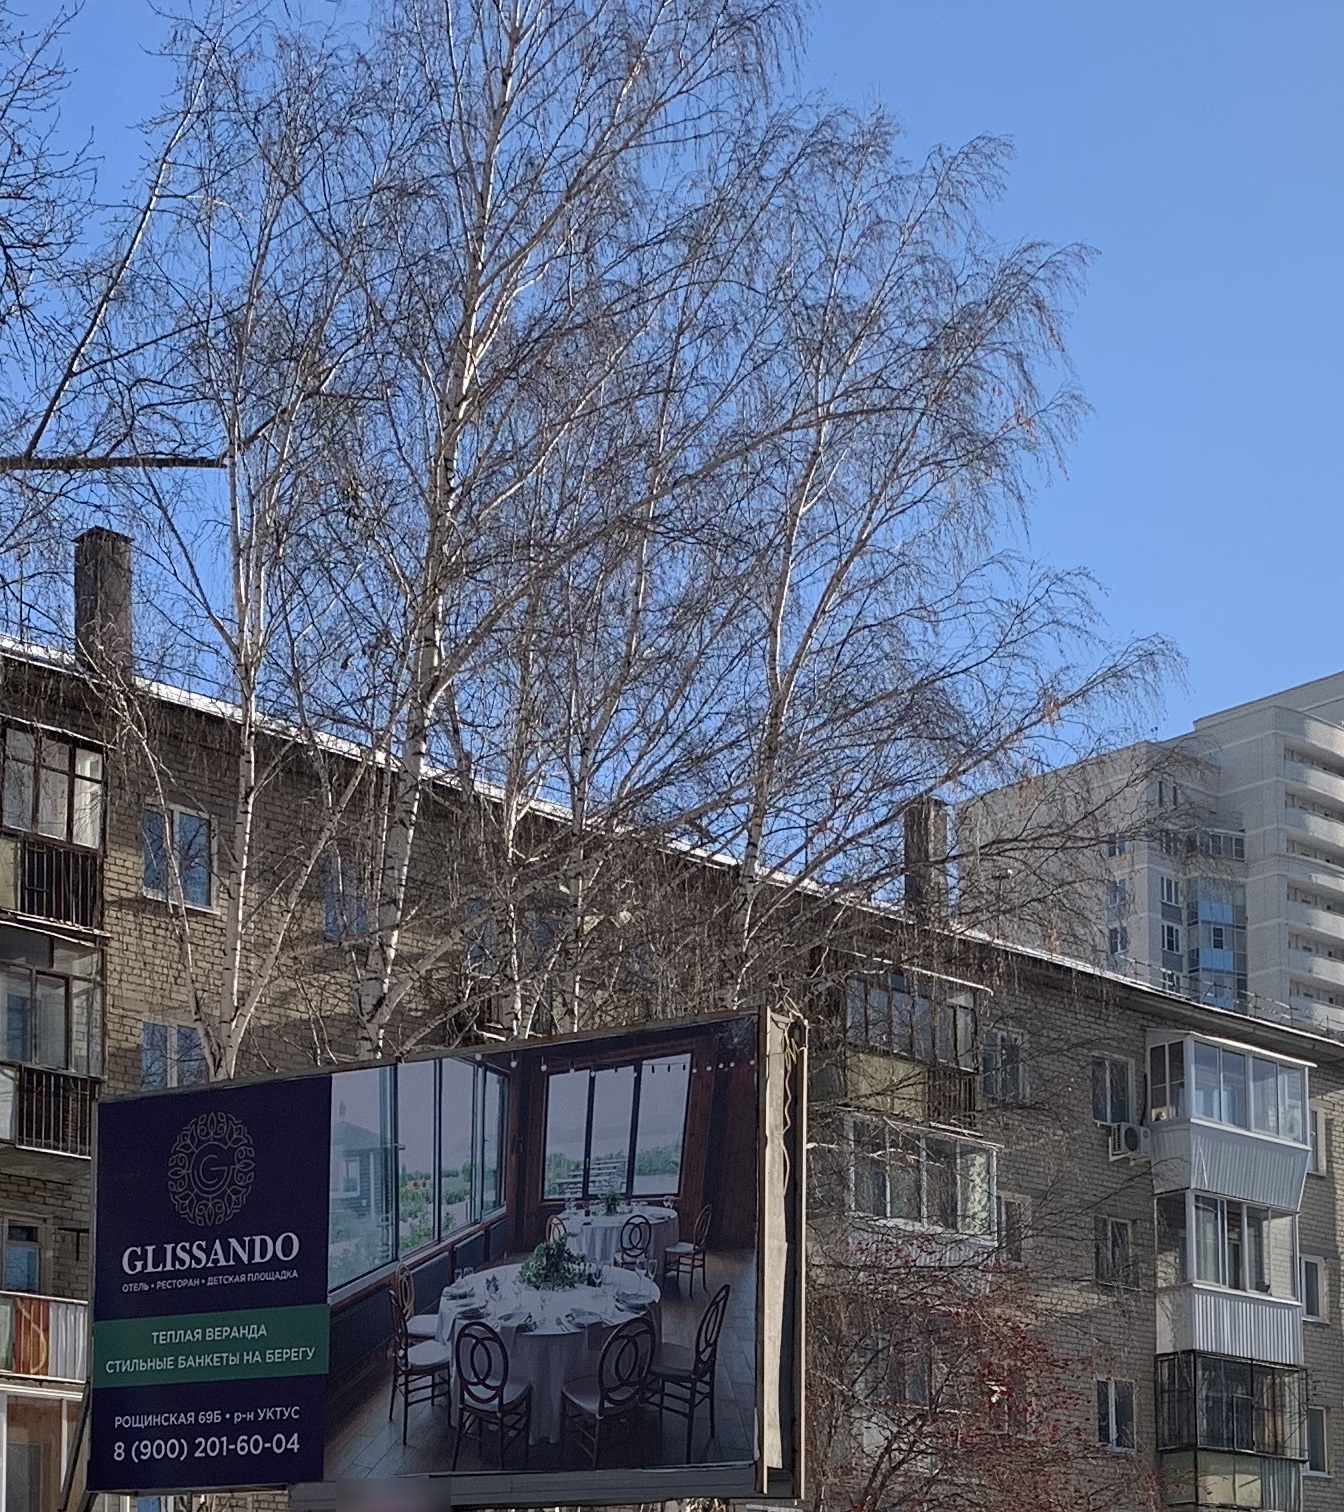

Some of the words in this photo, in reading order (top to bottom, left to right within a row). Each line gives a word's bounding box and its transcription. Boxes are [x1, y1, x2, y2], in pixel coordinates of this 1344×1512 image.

[121, 1232, 300, 1275] GLISSANDO
[121, 1282, 150, 1293] ОТЕЛЬ
[156, 1278, 200, 1290] РЕСТОРАН
[207, 1274, 246, 1286] ДЕТСКАЯ
[247, 1269, 299, 1283] ПЛОЩАДКА
[152, 1329, 202, 1345] ТЕПЛАЯ
[206, 1324, 268, 1341] ВЕРАНДА
[106, 1357, 175, 1374] СТИЛЬНЫЕ
[178, 1353, 240, 1368] БАНКЕТЫ
[243, 1351, 262, 1365] НА
[266, 1347, 316, 1363] БЕРЕГУ
[114, 1412, 195, 1429] РОЩИНСКАЯ
[198, 1410, 222, 1424] 69Б
[234, 1409, 254, 1424] р-н
[257, 1406, 301, 1421] УКТУС
[113, 1441, 125, 1461] 8
[131, 1438, 188, 1463] (900)
[194, 1432, 300, 1458] 201-60-04
